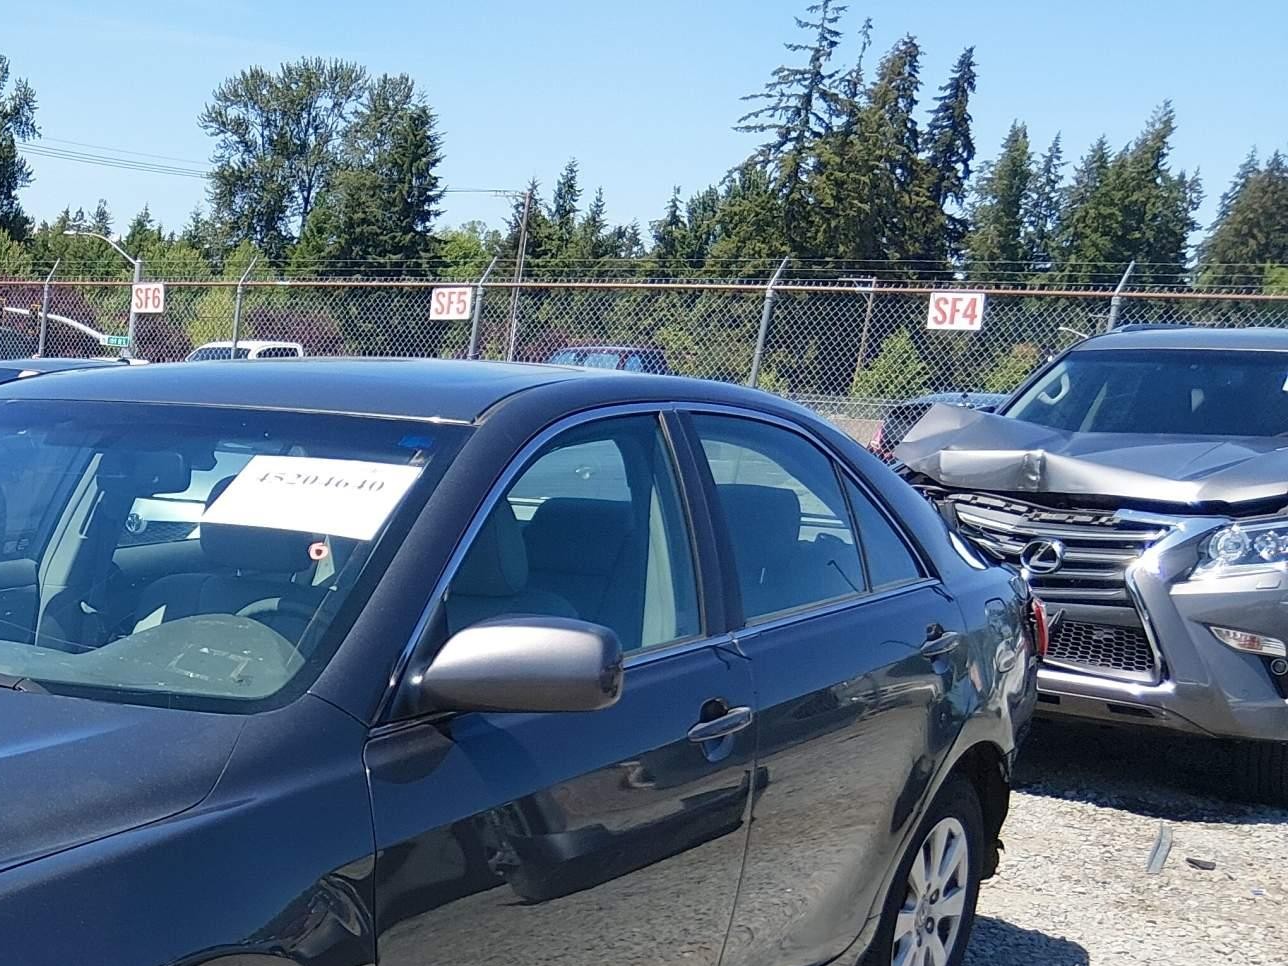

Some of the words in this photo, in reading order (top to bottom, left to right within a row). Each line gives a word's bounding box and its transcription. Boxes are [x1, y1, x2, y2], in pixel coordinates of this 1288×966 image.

[134, 287, 161, 310] SF6
[434, 291, 467, 315] SF5
[932, 296, 978, 326] SF4
